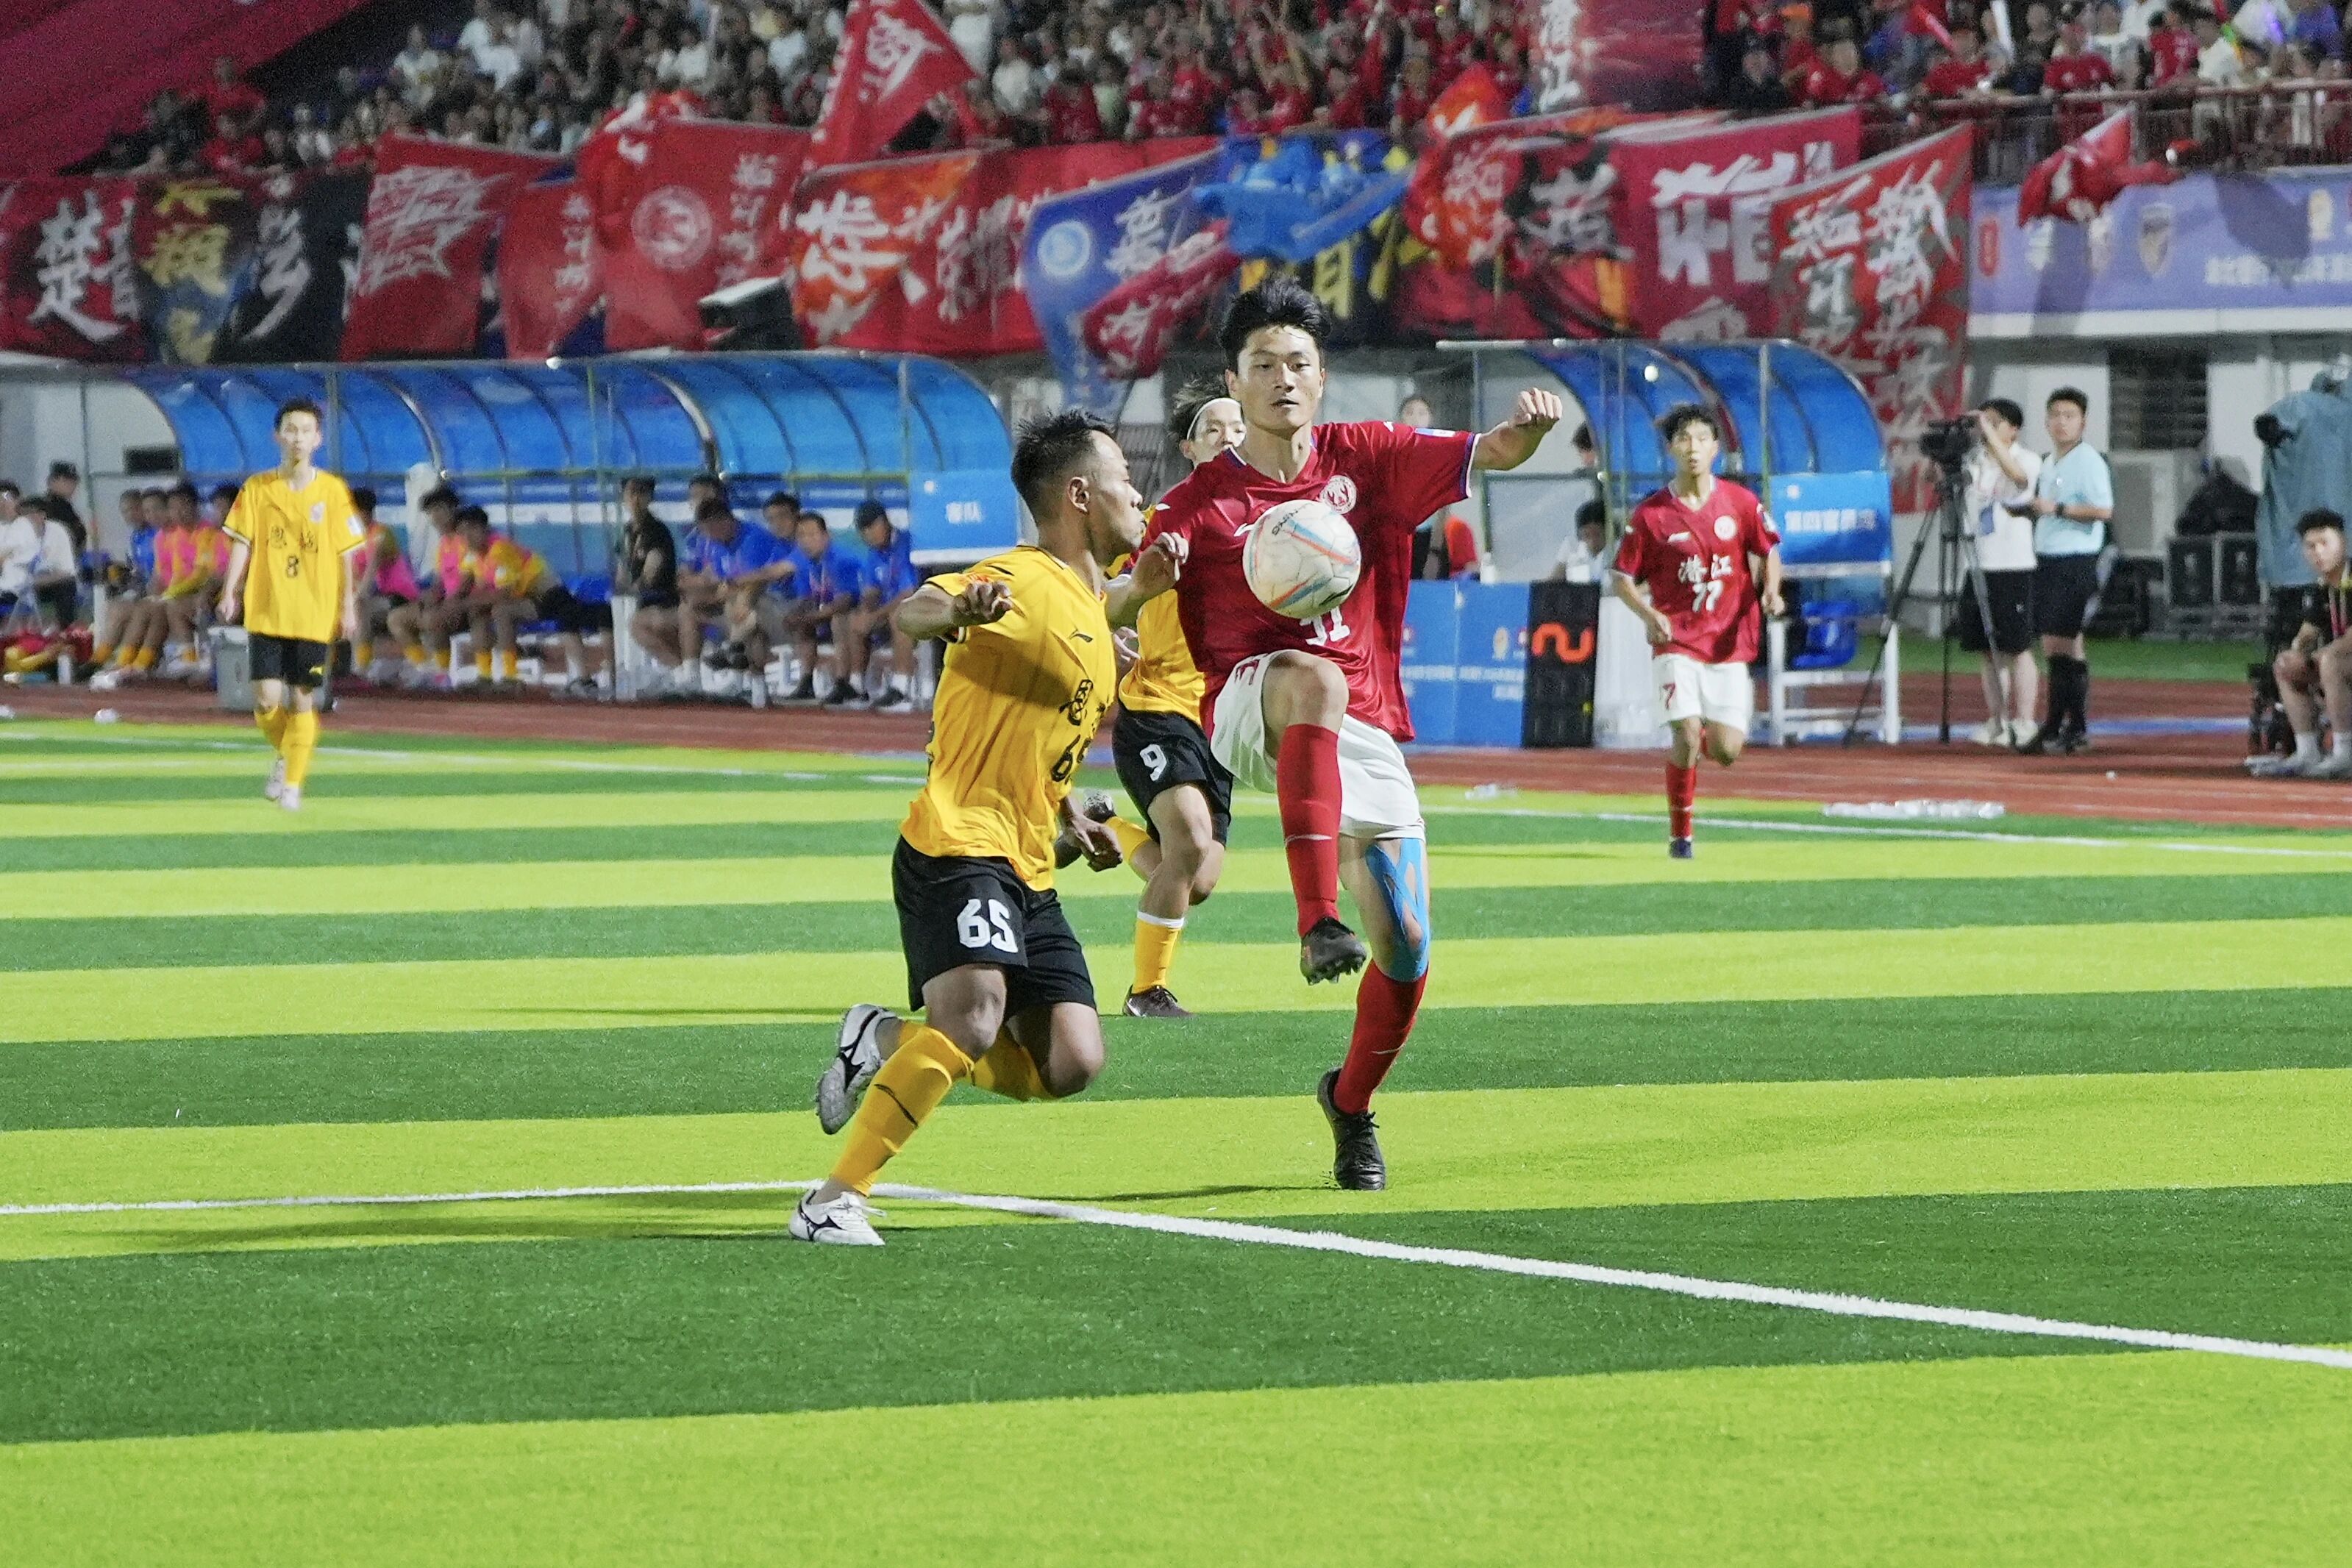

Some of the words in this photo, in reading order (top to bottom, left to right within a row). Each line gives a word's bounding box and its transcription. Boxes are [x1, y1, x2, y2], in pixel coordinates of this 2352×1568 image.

[286, 555, 299, 578] 8
[1139, 743, 1167, 782] 9
[956, 898, 1019, 953] 65
